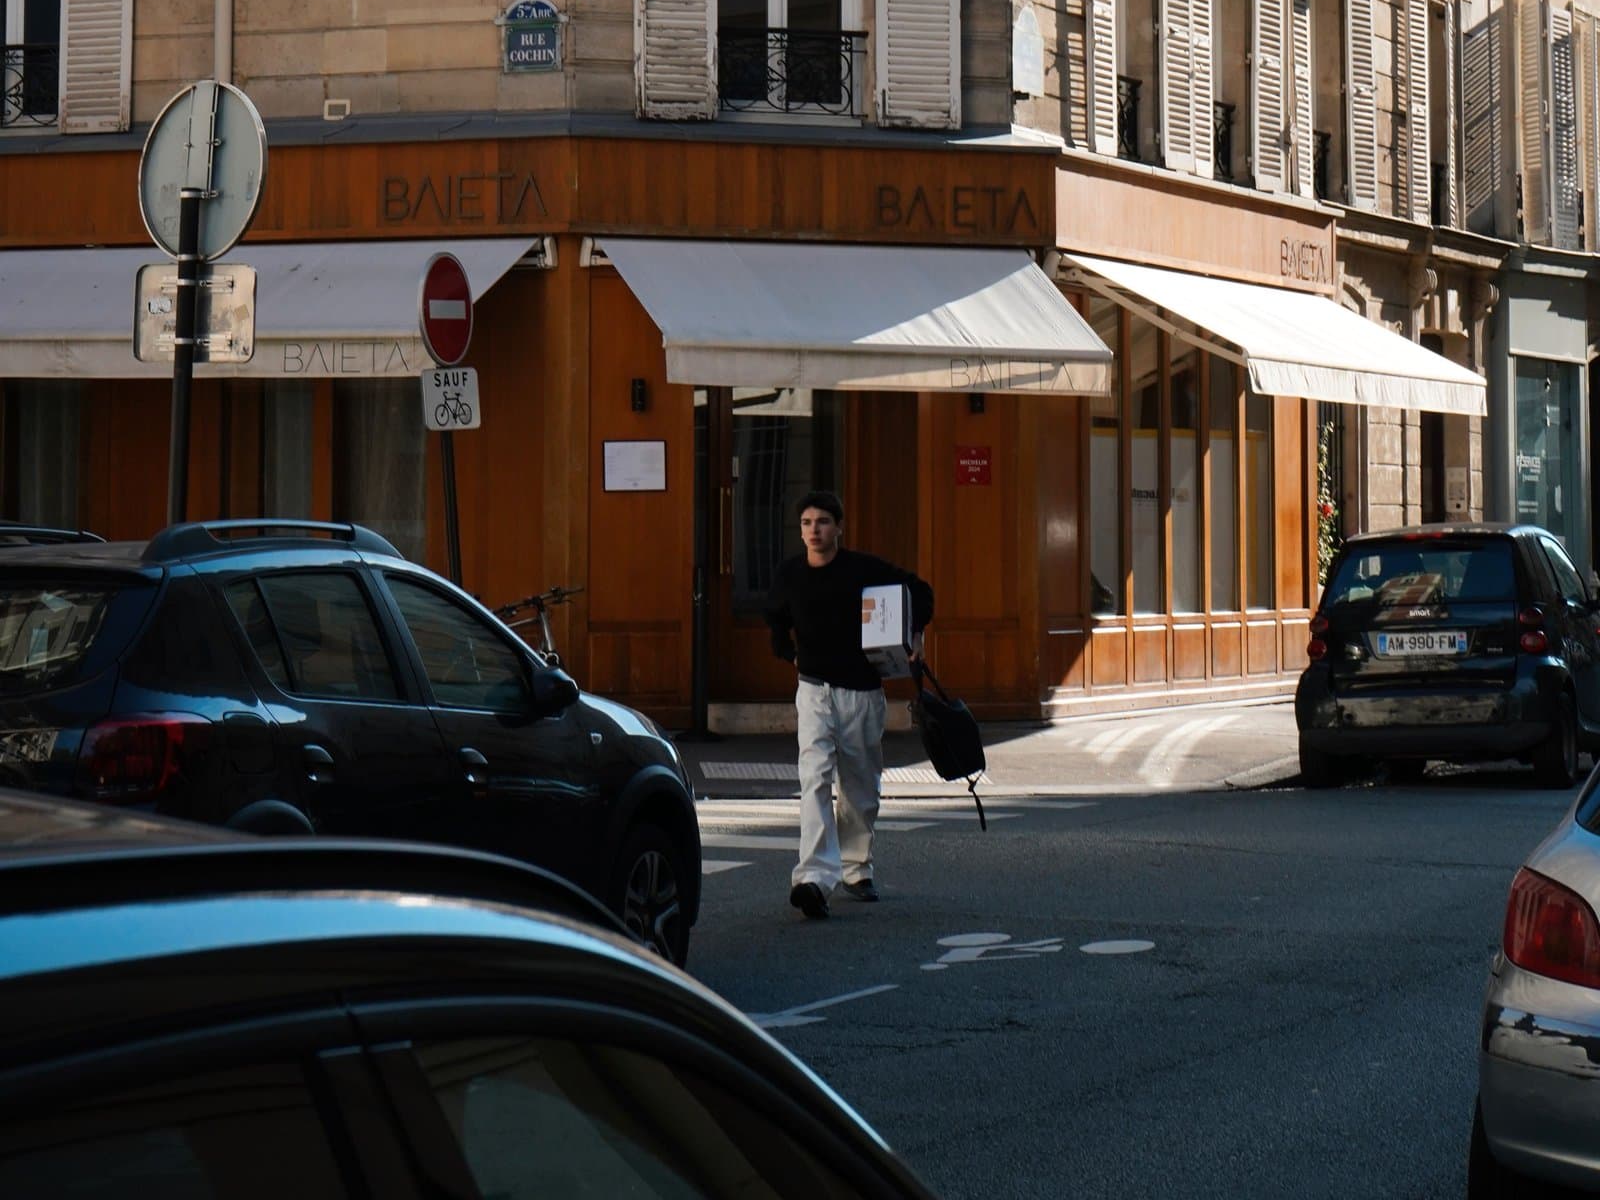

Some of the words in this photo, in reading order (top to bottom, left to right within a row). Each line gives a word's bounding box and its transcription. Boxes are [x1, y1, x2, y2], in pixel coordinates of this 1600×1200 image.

[521, 33, 546, 46] RUE
[510, 49, 556, 62] COCHIN
[383, 175, 549, 223] BAIETA
[1281, 239, 1327, 284] BAIETA
[283, 341, 410, 374] BAIETA
[434, 371, 469, 388] SAUF
[950, 357, 1075, 392] BAIETA
[1409, 609, 1431, 617] smart
